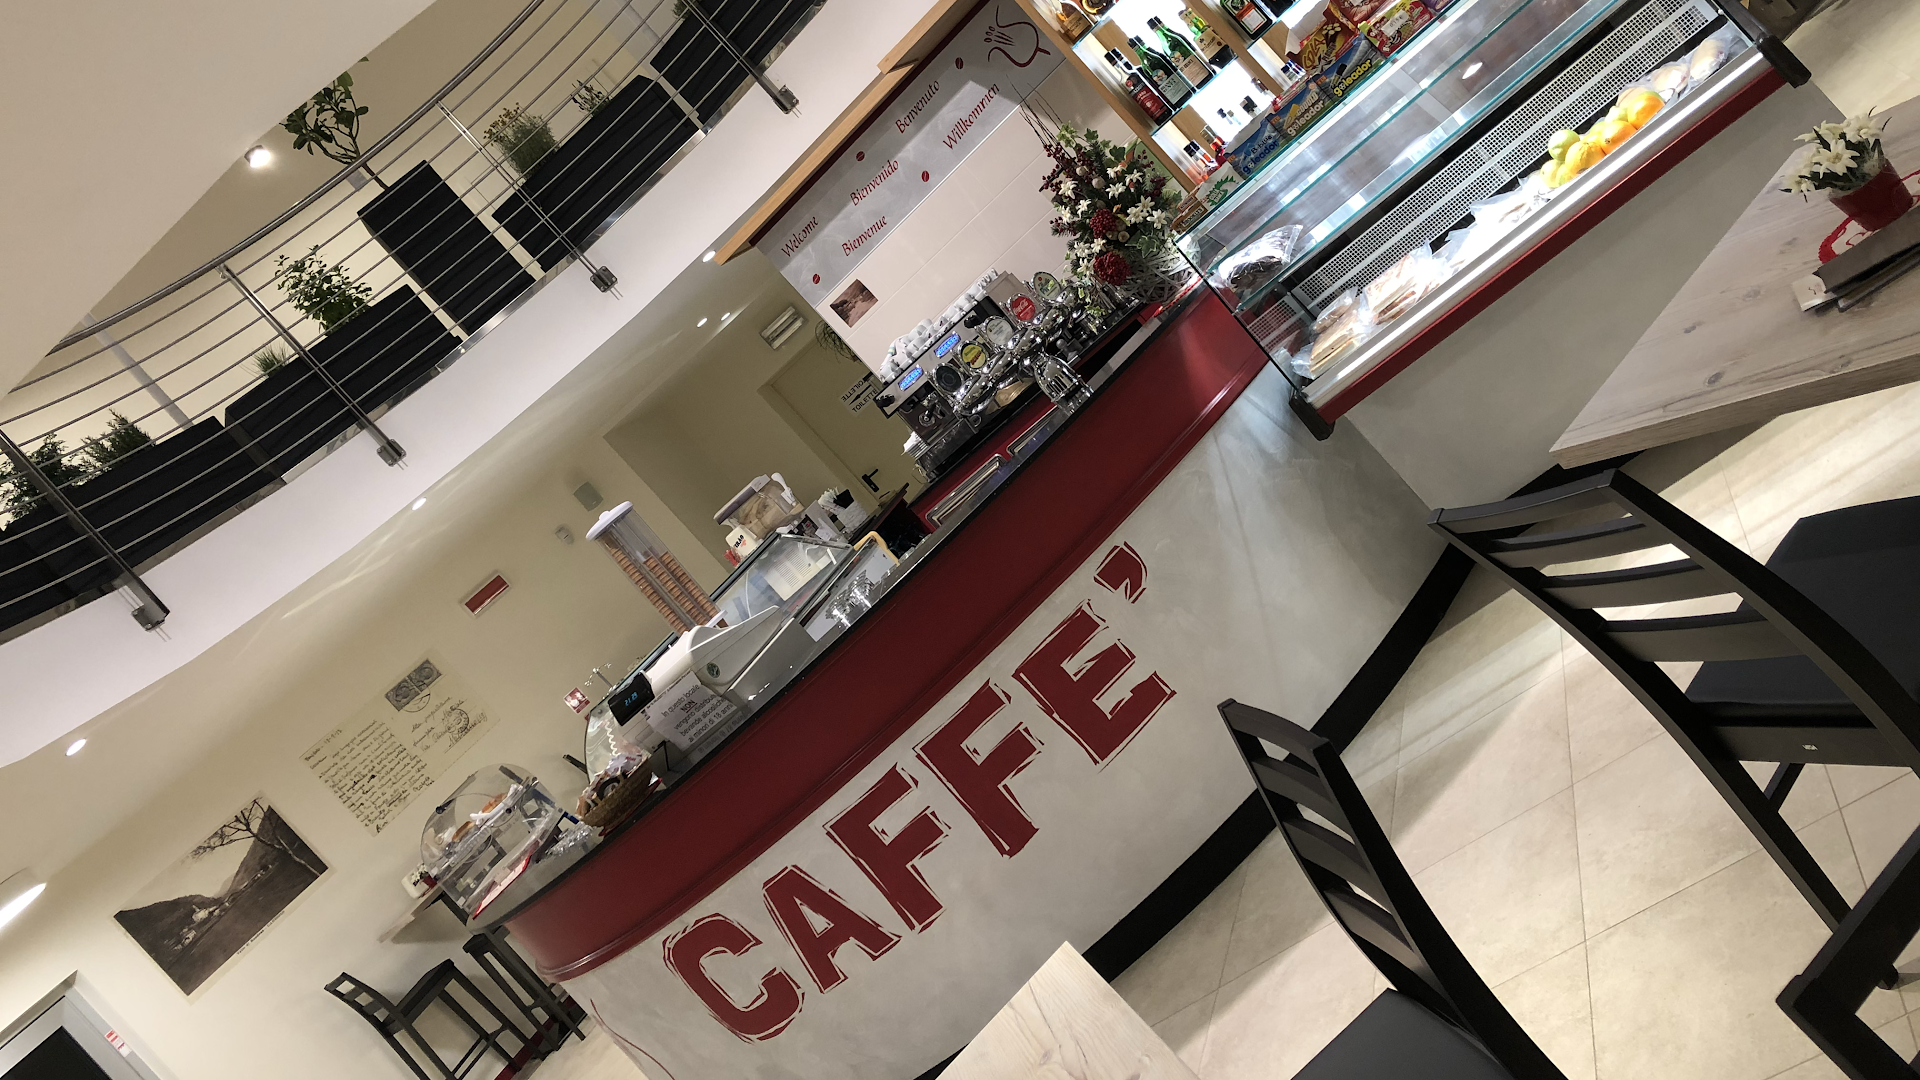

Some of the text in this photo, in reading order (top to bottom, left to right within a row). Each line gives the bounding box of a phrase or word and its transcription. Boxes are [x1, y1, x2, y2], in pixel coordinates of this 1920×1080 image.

[1333, 59, 1372, 97] goleador
[895, 79, 940, 134] Benvenuto
[942, 83, 999, 150] Willkommen
[1287, 99, 1325, 137] goleador
[1242, 139, 1279, 175] goleador
[849, 160, 899, 206] Bienvenido
[781, 216, 819, 258] Welcome
[841, 215, 888, 257] Bienvenue
[851, 388, 879, 413] TOILETTE
[668, 697, 685, 713] questo
[683, 684, 700, 698] locale
[680, 699, 696, 713] NON
[674, 711, 696, 730] vengono
[679, 718, 703, 737] bevande
[693, 723, 710, 738] minori
[713, 711, 721, 720] 18
[720, 703, 734, 715] anni
[662, 541, 1176, 1044] CAFFE'
